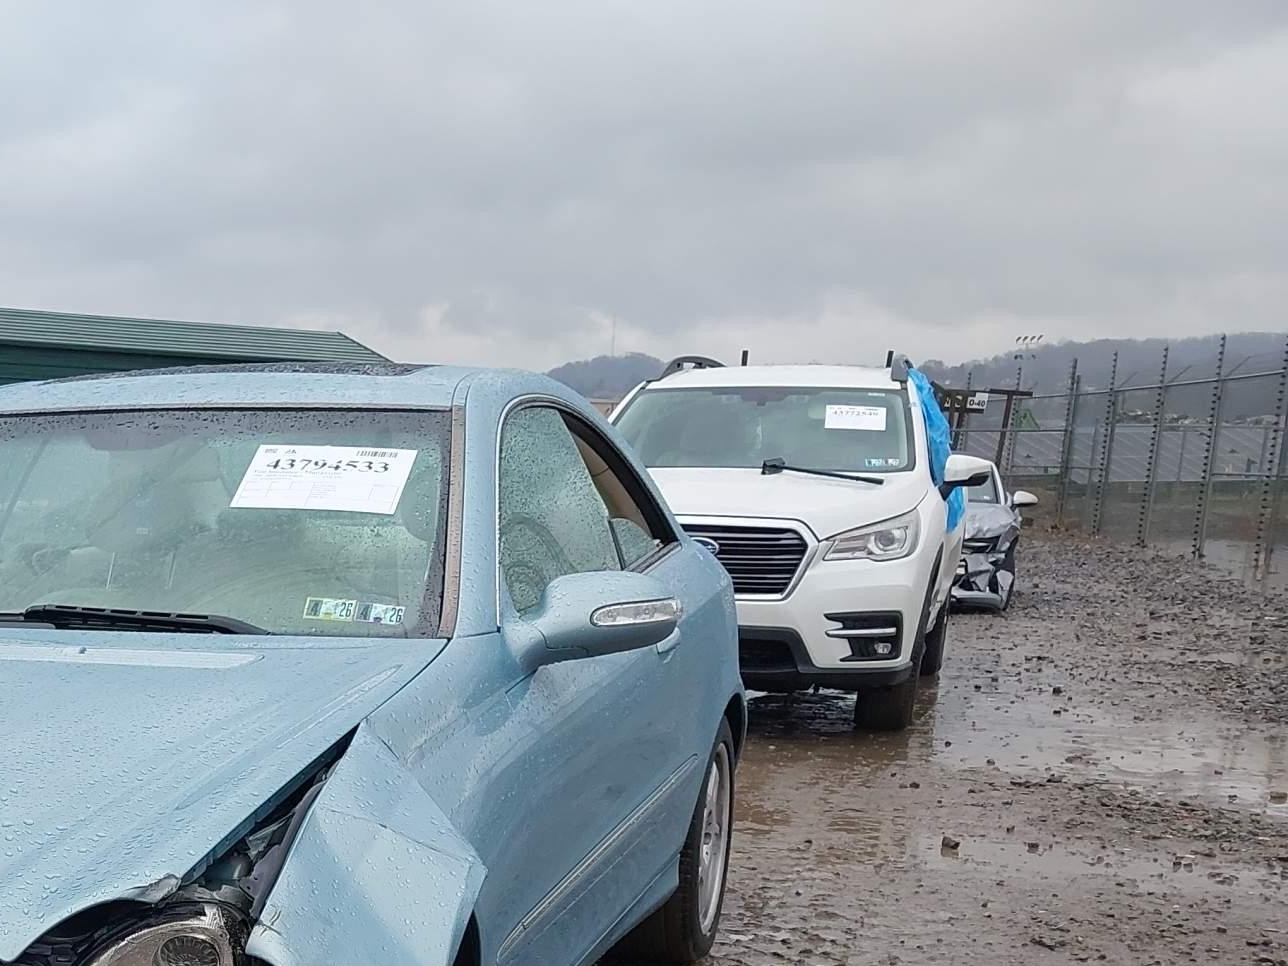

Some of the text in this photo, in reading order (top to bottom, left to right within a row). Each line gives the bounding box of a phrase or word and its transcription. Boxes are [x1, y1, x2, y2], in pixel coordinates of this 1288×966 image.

[266, 458, 390, 473] 43794533
[339, 602, 353, 618] 26
[389, 607, 403, 623] 26
